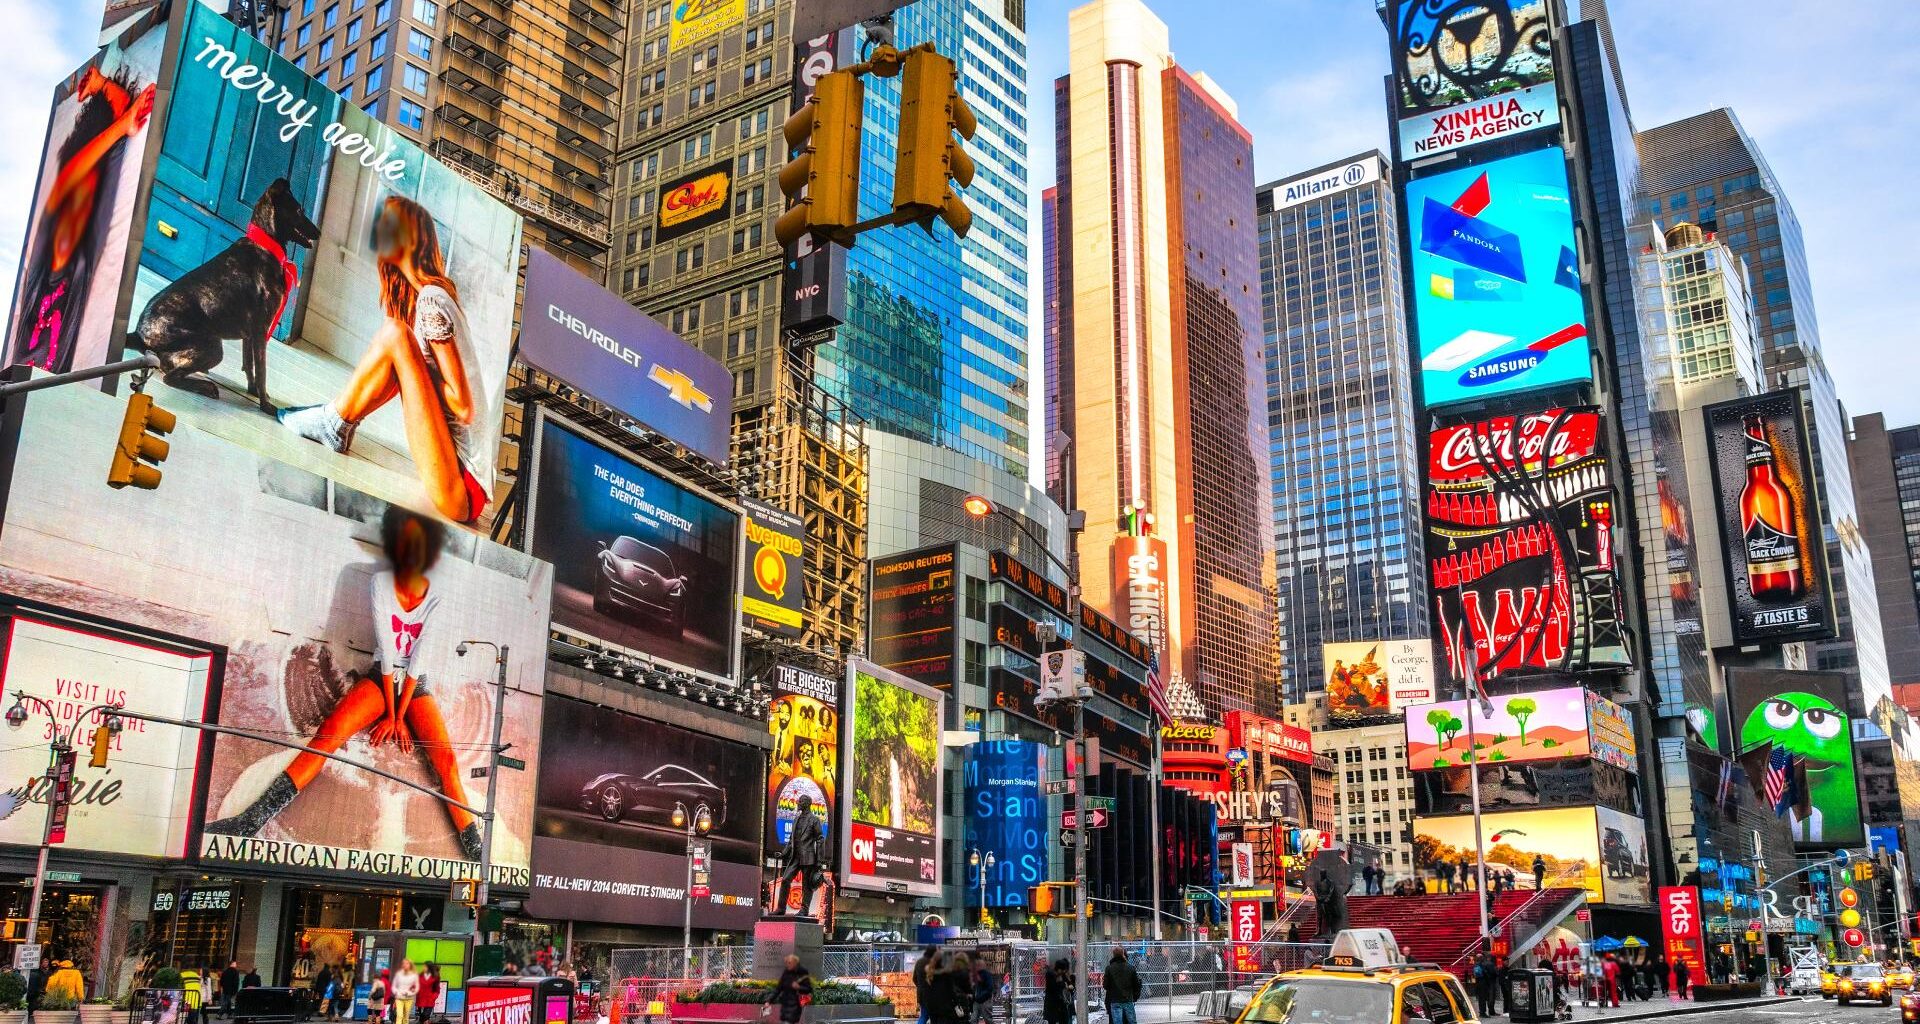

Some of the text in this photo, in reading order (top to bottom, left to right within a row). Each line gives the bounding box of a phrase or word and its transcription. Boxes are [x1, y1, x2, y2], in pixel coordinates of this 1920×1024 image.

[194, 36, 407, 183] merry aerie
[1432, 98, 1523, 134] XINHUA
[1415, 110, 1544, 153] NEWS AGENCY
[1286, 176, 1340, 202] Allianz
[1453, 230, 1501, 253] PANDORA
[796, 284, 820, 300] NYC
[548, 303, 642, 368] CHEVROLET
[1470, 356, 1537, 378] SAMSUNG
[594, 464, 645, 498] THE CAR DOES
[610, 486, 692, 532] EVERYTHING PERFECTLY
[745, 516, 802, 557] Avenue
[1750, 545, 1794, 558] BLACK CROWN
[754, 544, 786, 600] Q
[876, 553, 952, 576] THOMSON REUTERS
[1007, 559, 1023, 584] N/A
[1028, 572, 1043, 596] N/A
[1048, 585, 1062, 608] N/A
[1754, 608, 1808, 626] #TASTE IS
[1404, 644, 1415, 656] By
[777, 665, 836, 696] THE BIGGEST
[778, 682, 787, 690] BOX
[788, 684, 802, 693] OFFICE
[1398, 675, 1424, 684] did it.
[56, 678, 126, 708] VISIT US
[24, 697, 83, 722] INSIDE
[78, 728, 122, 750] LEL
[988, 778, 1037, 787] Morgan Stanley
[1052, 783, 1060, 793] 46
[206, 834, 530, 887] AMERICAN EAGLE OUTFITTERS
[852, 838, 873, 862] CNN
[52, 872, 80, 882] BROADWAY
[536, 874, 685, 900] THE ALL-NEW 2014 CORVETTE STINGRAY
[710, 894, 754, 906] FIND NEW ROADS
[1669, 891, 1692, 934] tkts
[1239, 904, 1256, 941] tkts
[469, 1003, 531, 1024] JERSEY BOYS
